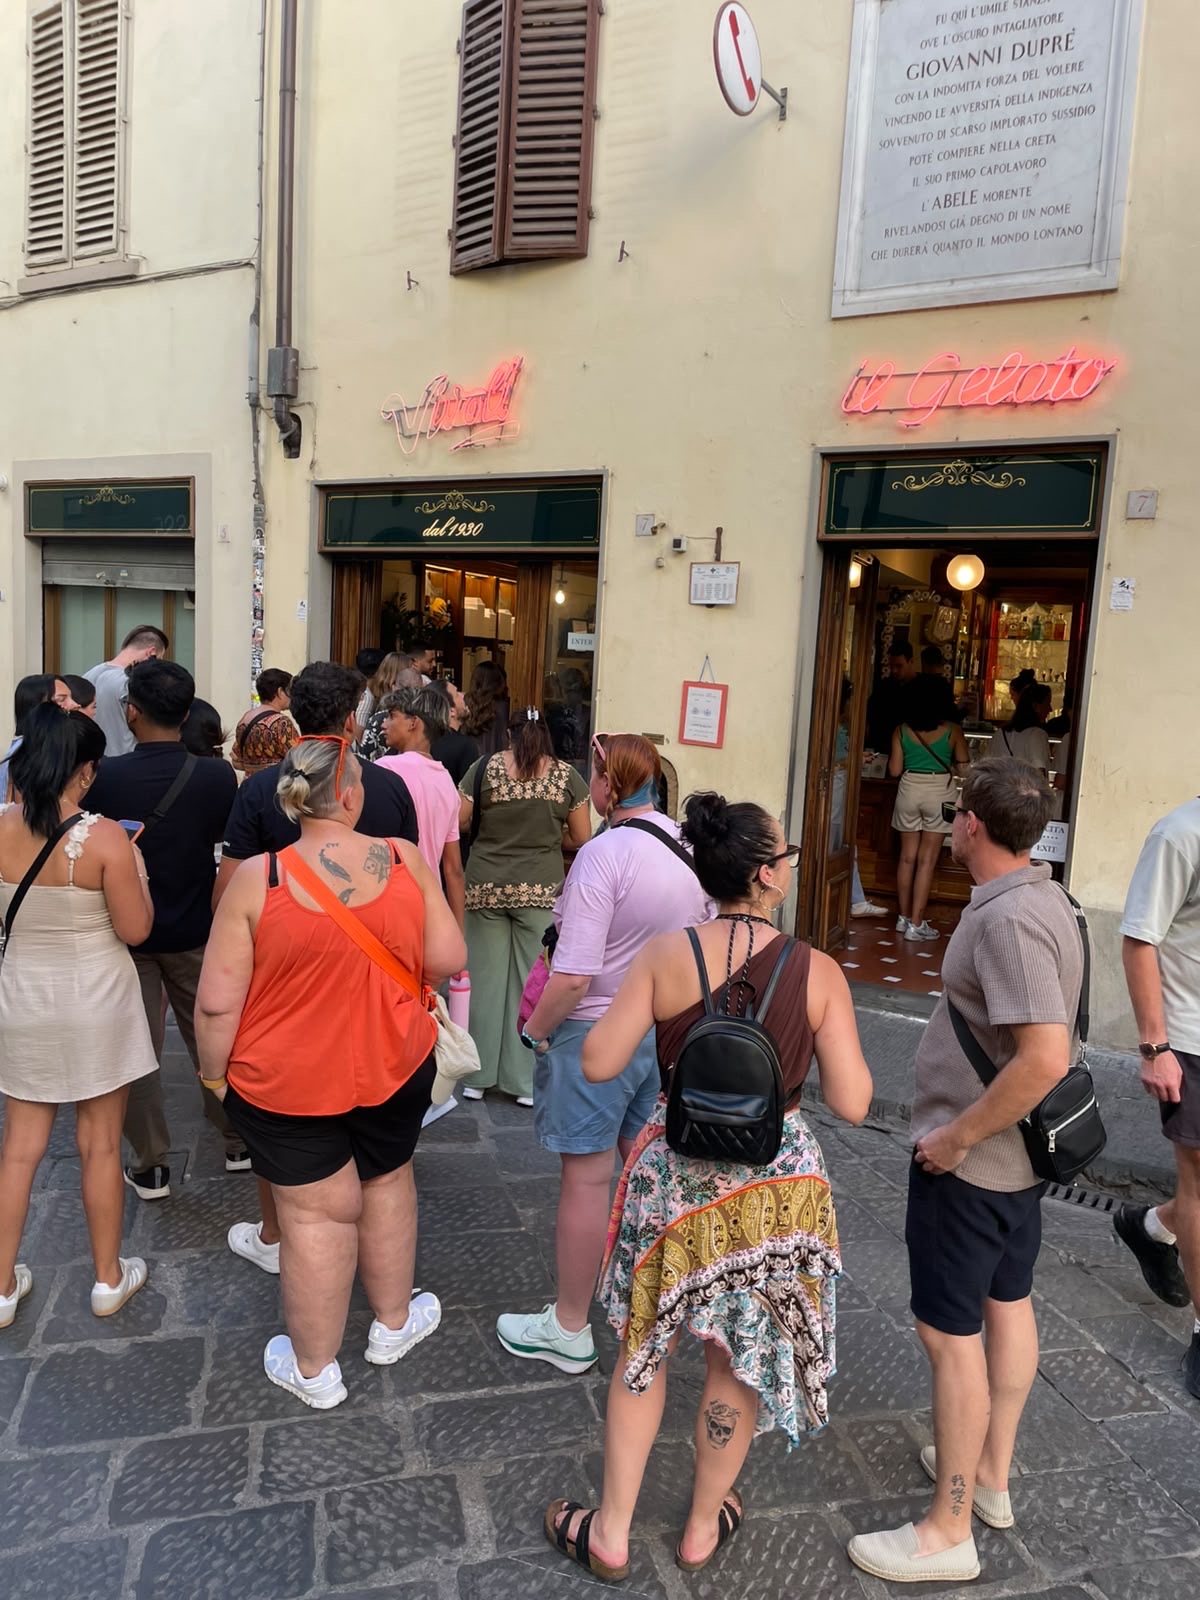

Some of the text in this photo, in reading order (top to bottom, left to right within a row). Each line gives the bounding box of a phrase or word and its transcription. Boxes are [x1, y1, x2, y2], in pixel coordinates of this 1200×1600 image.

[935, 13, 947, 26] FU
[1013, 0, 1051, 9] STAN
[920, 36, 939, 50] OVE
[992, 12, 1064, 36] INTAGLIATORE
[906, 46, 1002, 80] GIOVANNI
[894, 61, 1085, 105] CON LA INDOMITA FORZA DEL VOLERE
[885, 110, 932, 127] VINCENDO
[935, 107, 946, 119] LE
[1005, 93, 1034, 107] DELLA
[1038, 83, 1093, 101] INDIGENZA
[879, 104, 1096, 151] SOVVENUTO DI SCARSO IMPLORATO SUSSIDIO
[937, 144, 985, 162] COMPIERE
[989, 139, 1020, 154] NELLA
[1024, 134, 1056, 148] CRETA
[912, 157, 1047, 188] IL SUO PRIMO CAPOLAVORO
[982, 186, 1033, 204] MORENTE
[884, 220, 946, 239] RIVELANDOSI
[970, 212, 1004, 227] DEGNO
[1008, 210, 1018, 222] DI
[1022, 208, 1036, 220] UN
[1040, 203, 1071, 218] NOME
[871, 249, 888, 261] CHE
[932, 238, 973, 257] QUANTO
[976, 236, 985, 249] IL
[990, 231, 1030, 247] MONDO
[1033, 224, 1084, 241] LONTANO
[898, 346, 1119, 425] Gelato
[422, 516, 484, 537] dal 1930
[571, 637, 593, 646] ENTER
[1036, 844, 1057, 854] EXIT
